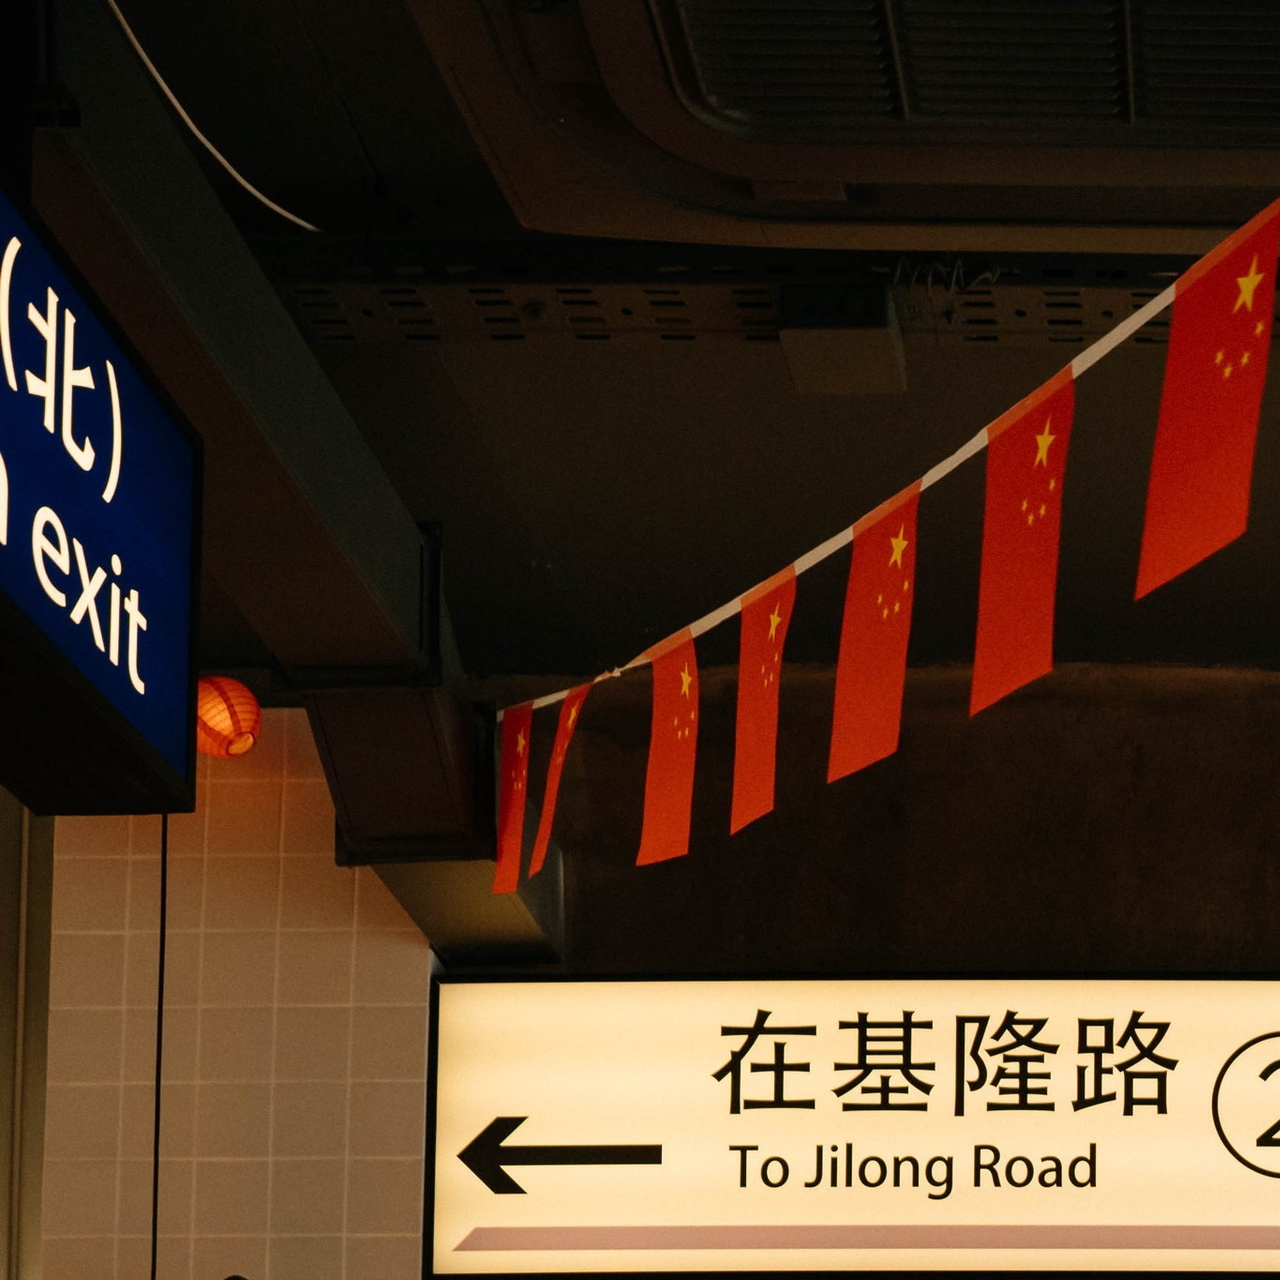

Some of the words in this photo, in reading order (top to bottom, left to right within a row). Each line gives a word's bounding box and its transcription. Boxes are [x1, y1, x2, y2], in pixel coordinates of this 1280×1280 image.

[32, 505, 148, 696] exit
[712, 1008, 1180, 1117] 在基隆路
[729, 1145, 790, 1188] To
[804, 1143, 955, 1200] Jilong
[974, 1143, 1098, 1189] Road
